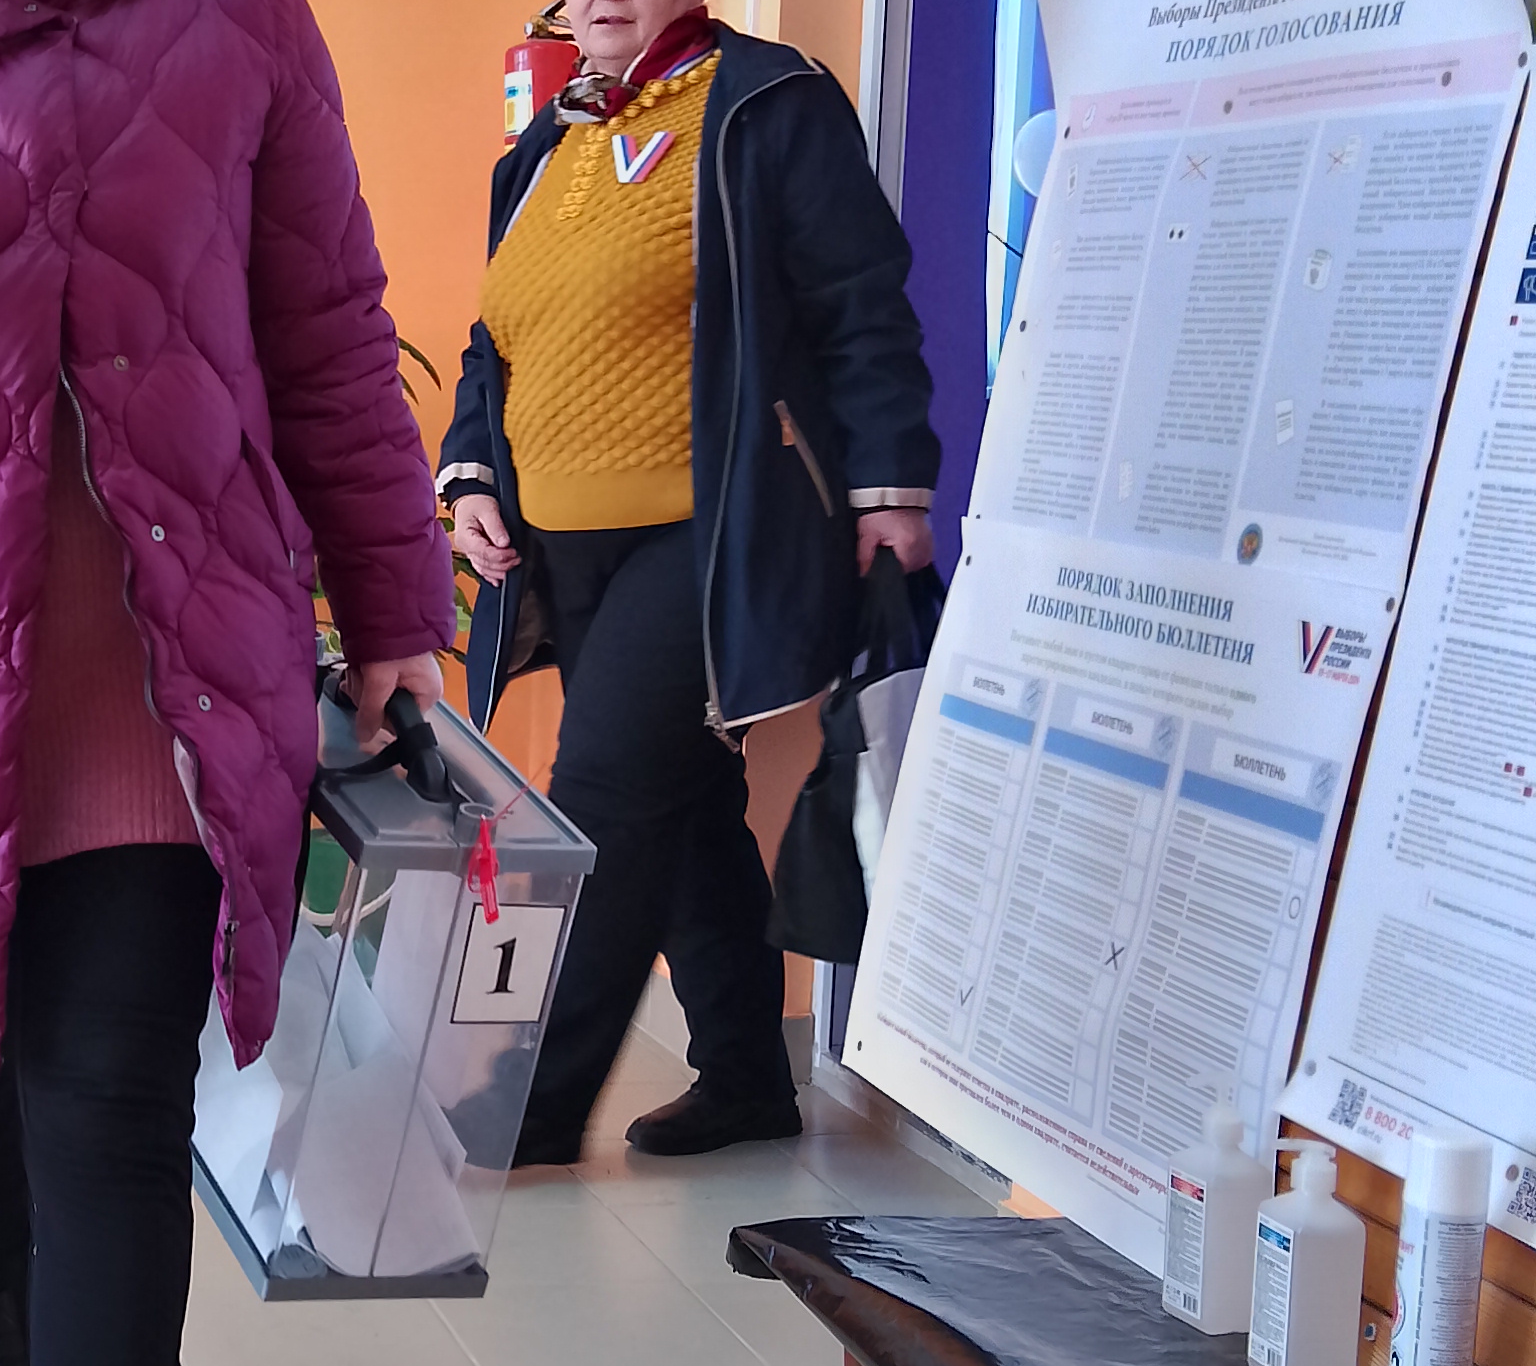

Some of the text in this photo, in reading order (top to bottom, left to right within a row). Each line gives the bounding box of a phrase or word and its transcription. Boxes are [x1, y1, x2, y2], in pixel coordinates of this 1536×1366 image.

[1147, 4, 1202, 29] Выборы
[1165, 0, 1407, 64] ПОРЯДОК ГОЛОСОВАНИЯ
[1056, 565, 1235, 623] ПОРЯДОК ЗАПОЛНЕНИЯ
[1025, 592, 1256, 666] ИЗБИРАТЕЛЬНОГО БЮЛЛЕТЕНЯ
[1334, 627, 1368, 644] ВЫБОРЫ
[1322, 654, 1352, 670] РОССИИ
[1329, 641, 1372, 660] ПРЕЗИДЕНТА
[972, 675, 1006, 697] БЮЛЛЕТЕНЬ
[1090, 710, 1135, 736] БЮЛЛЕТЕНЬ
[1232, 752, 1288, 782] БЮЛЛЕТЕНЬ
[485, 936, 518, 996] 1
[1364, 1106, 1374, 1121] 8
[1373, 1110, 1398, 1132] 800
[1397, 1121, 1414, 1141] 20
